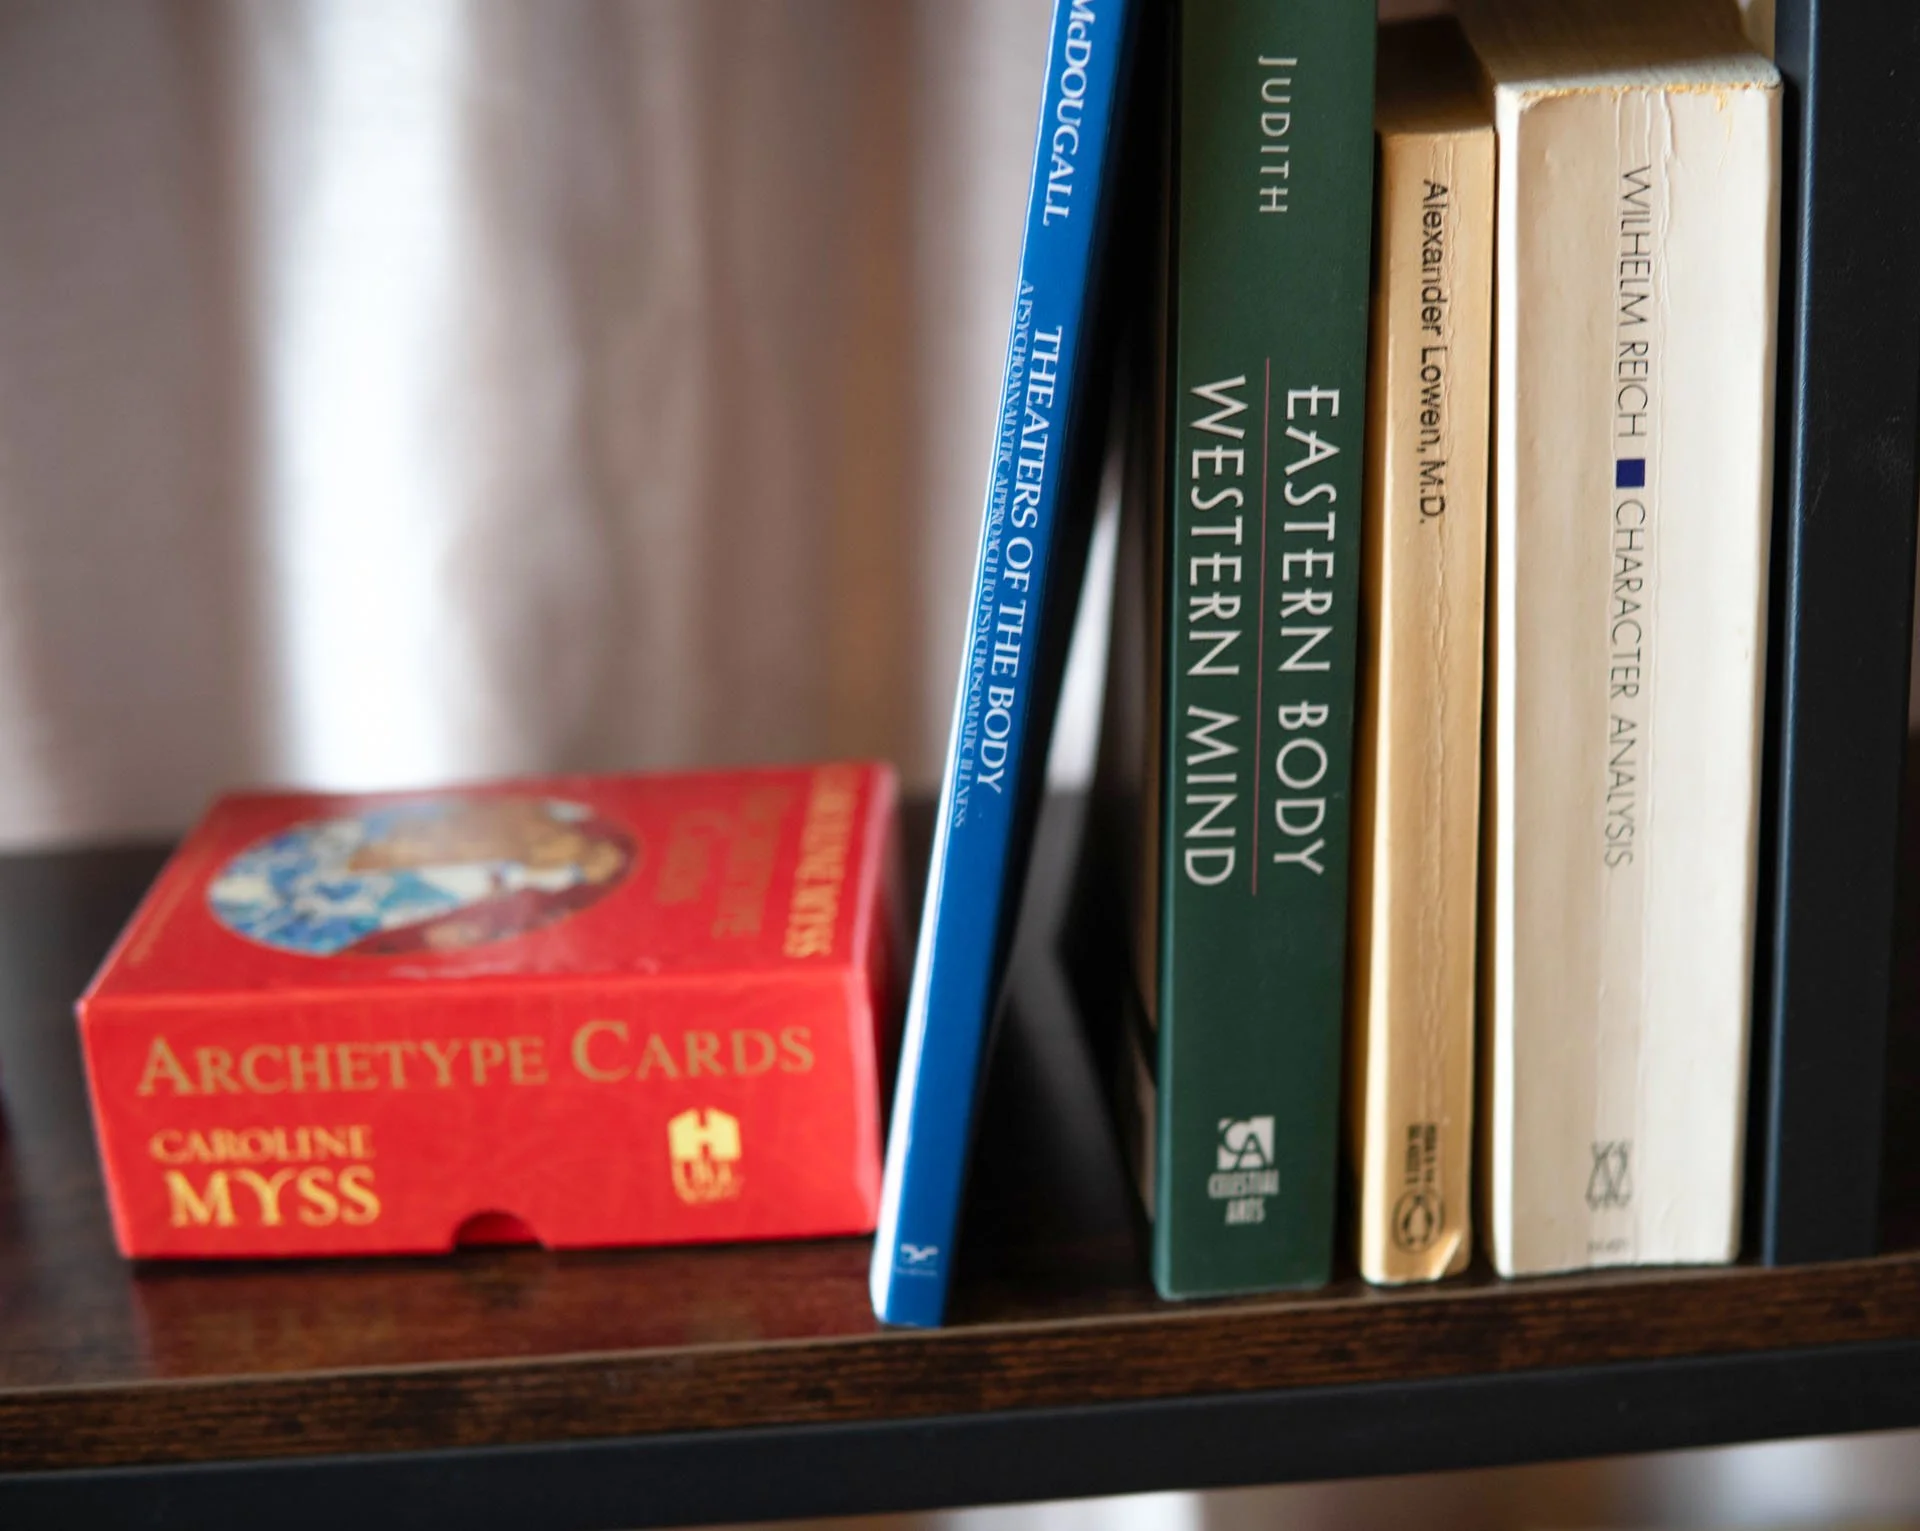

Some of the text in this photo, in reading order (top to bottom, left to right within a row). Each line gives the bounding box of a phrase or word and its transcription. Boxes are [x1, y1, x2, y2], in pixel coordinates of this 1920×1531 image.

[1257, 55, 1298, 213] JUDITH
[997, 299, 1034, 472] PSYCHOANALYTIC
[1020, 279, 1034, 296] A
[1417, 178, 1449, 525] Alexander Lowen, M.D.
[1617, 164, 1652, 438] WILHELM REICH
[975, 325, 1064, 795] THEATERS OF THE BODY
[1184, 374, 1249, 886] WESTERN MIND
[1273, 385, 1341, 876] EASTERN BODY
[1603, 499, 1647, 870] CHARACTER ANALYSIS
[136, 1020, 815, 1097] ARCHETYPE CARDS
[148, 1124, 375, 1165] CAROLINE
[163, 1165, 381, 1228] MYSS
